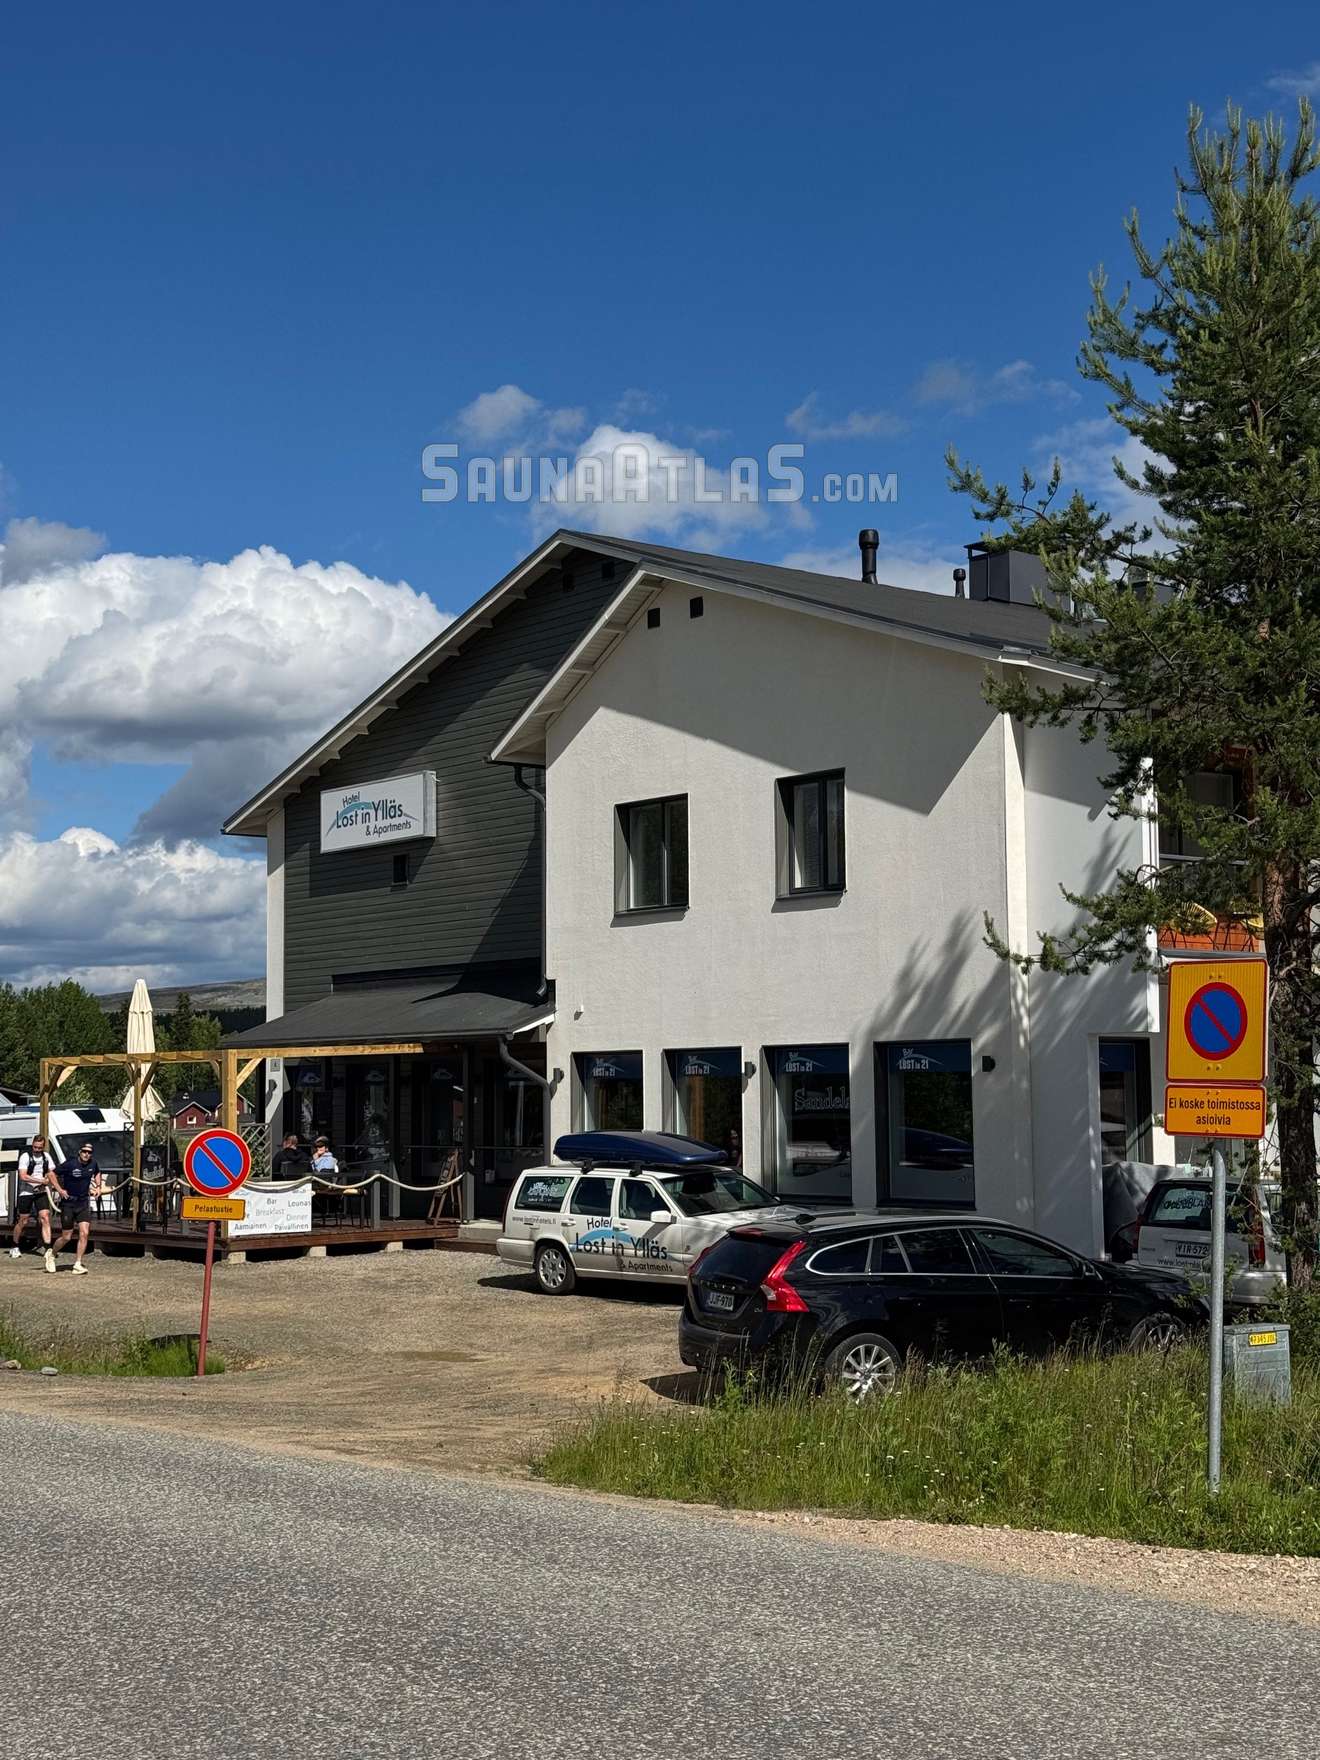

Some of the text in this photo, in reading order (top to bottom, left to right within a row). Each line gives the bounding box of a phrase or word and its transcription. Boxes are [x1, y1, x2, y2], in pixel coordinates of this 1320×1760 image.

[342, 791, 360, 808] Hotel
[336, 799, 403, 828] Lost in Ylläs
[365, 820, 412, 838] & Apartments
[785, 1062, 800, 1072] LOST
[805, 1062, 813, 1071] 21
[899, 1059, 914, 1070] LOST
[921, 1059, 929, 1070] 21
[1168, 1097, 1261, 1110] Ei koske toimistossa
[1196, 1113, 1231, 1126] asioivia
[266, 1198, 277, 1206] Bar
[194, 1204, 233, 1214] Pelastustie
[255, 1208, 285, 1217] Breakfast
[286, 1213, 308, 1221] Dinner
[586, 1217, 613, 1230] Hotel
[234, 1223, 267, 1231] Aamiainen
[575, 1232, 668, 1260] Lost in Ylläs
[628, 1260, 673, 1273] Apartments
